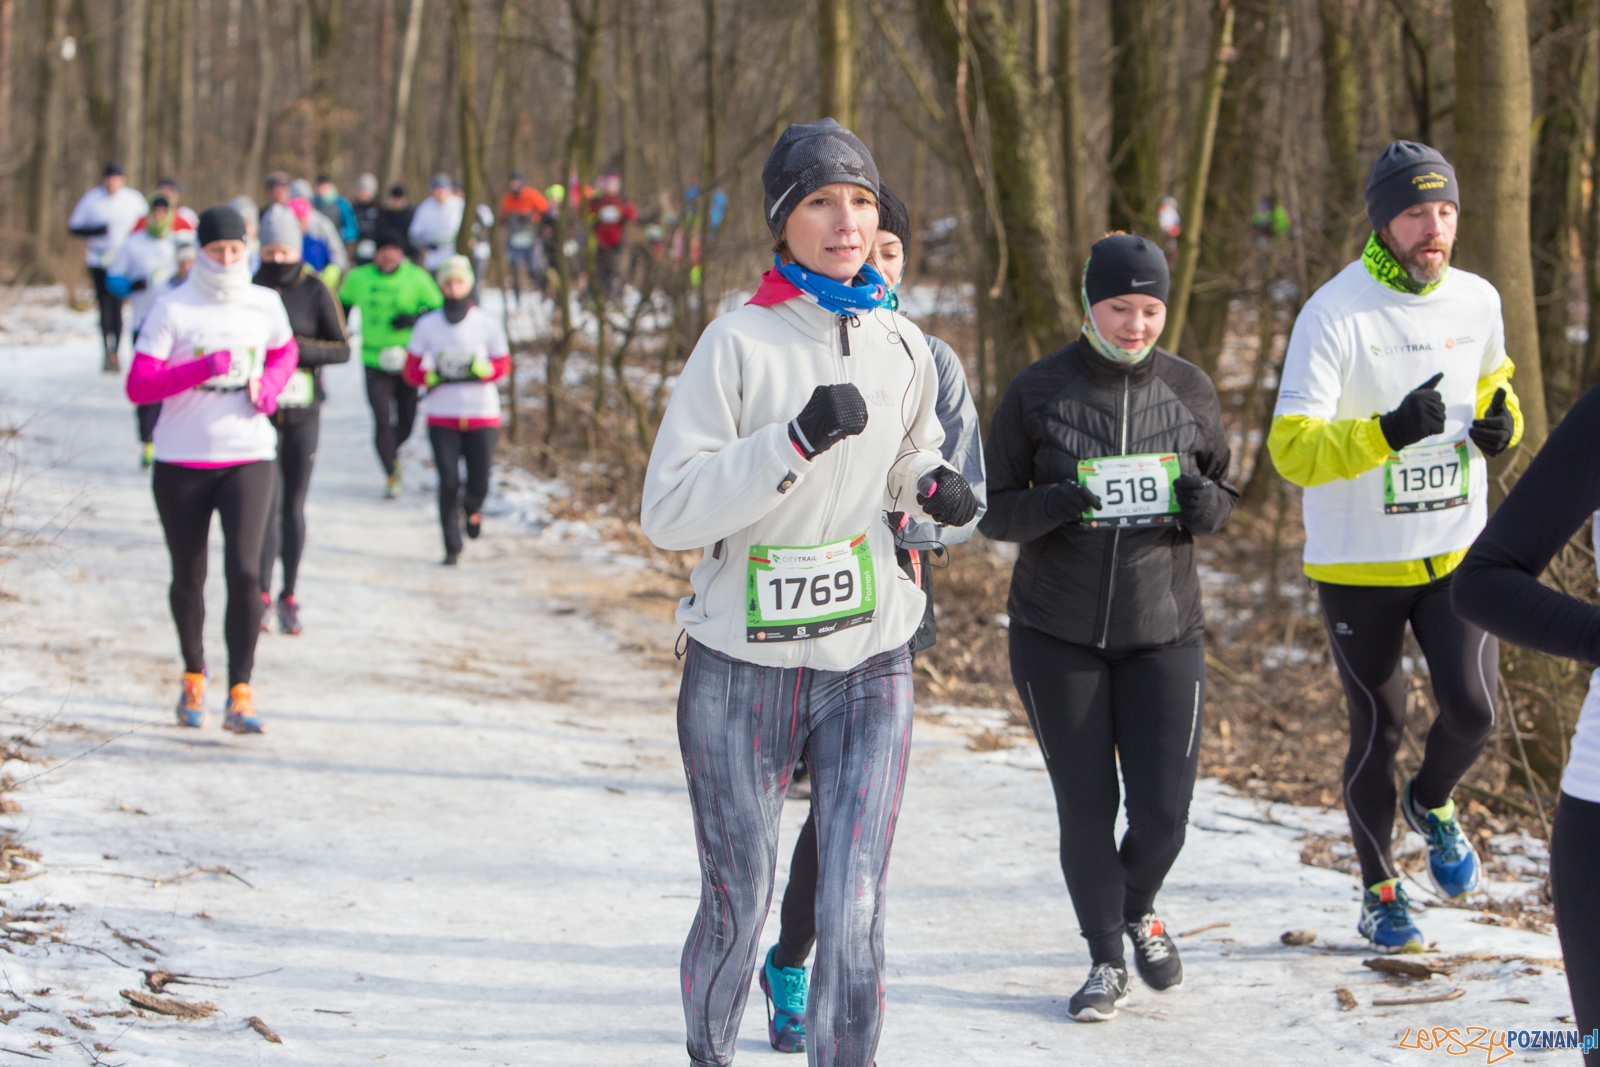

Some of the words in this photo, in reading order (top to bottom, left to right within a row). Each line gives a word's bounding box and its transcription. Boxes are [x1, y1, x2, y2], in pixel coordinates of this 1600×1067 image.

[1105, 476, 1158, 505] 518
[1398, 461, 1459, 492] 1307
[768, 569, 854, 610] 1769
[864, 571, 872, 602] Poznań
